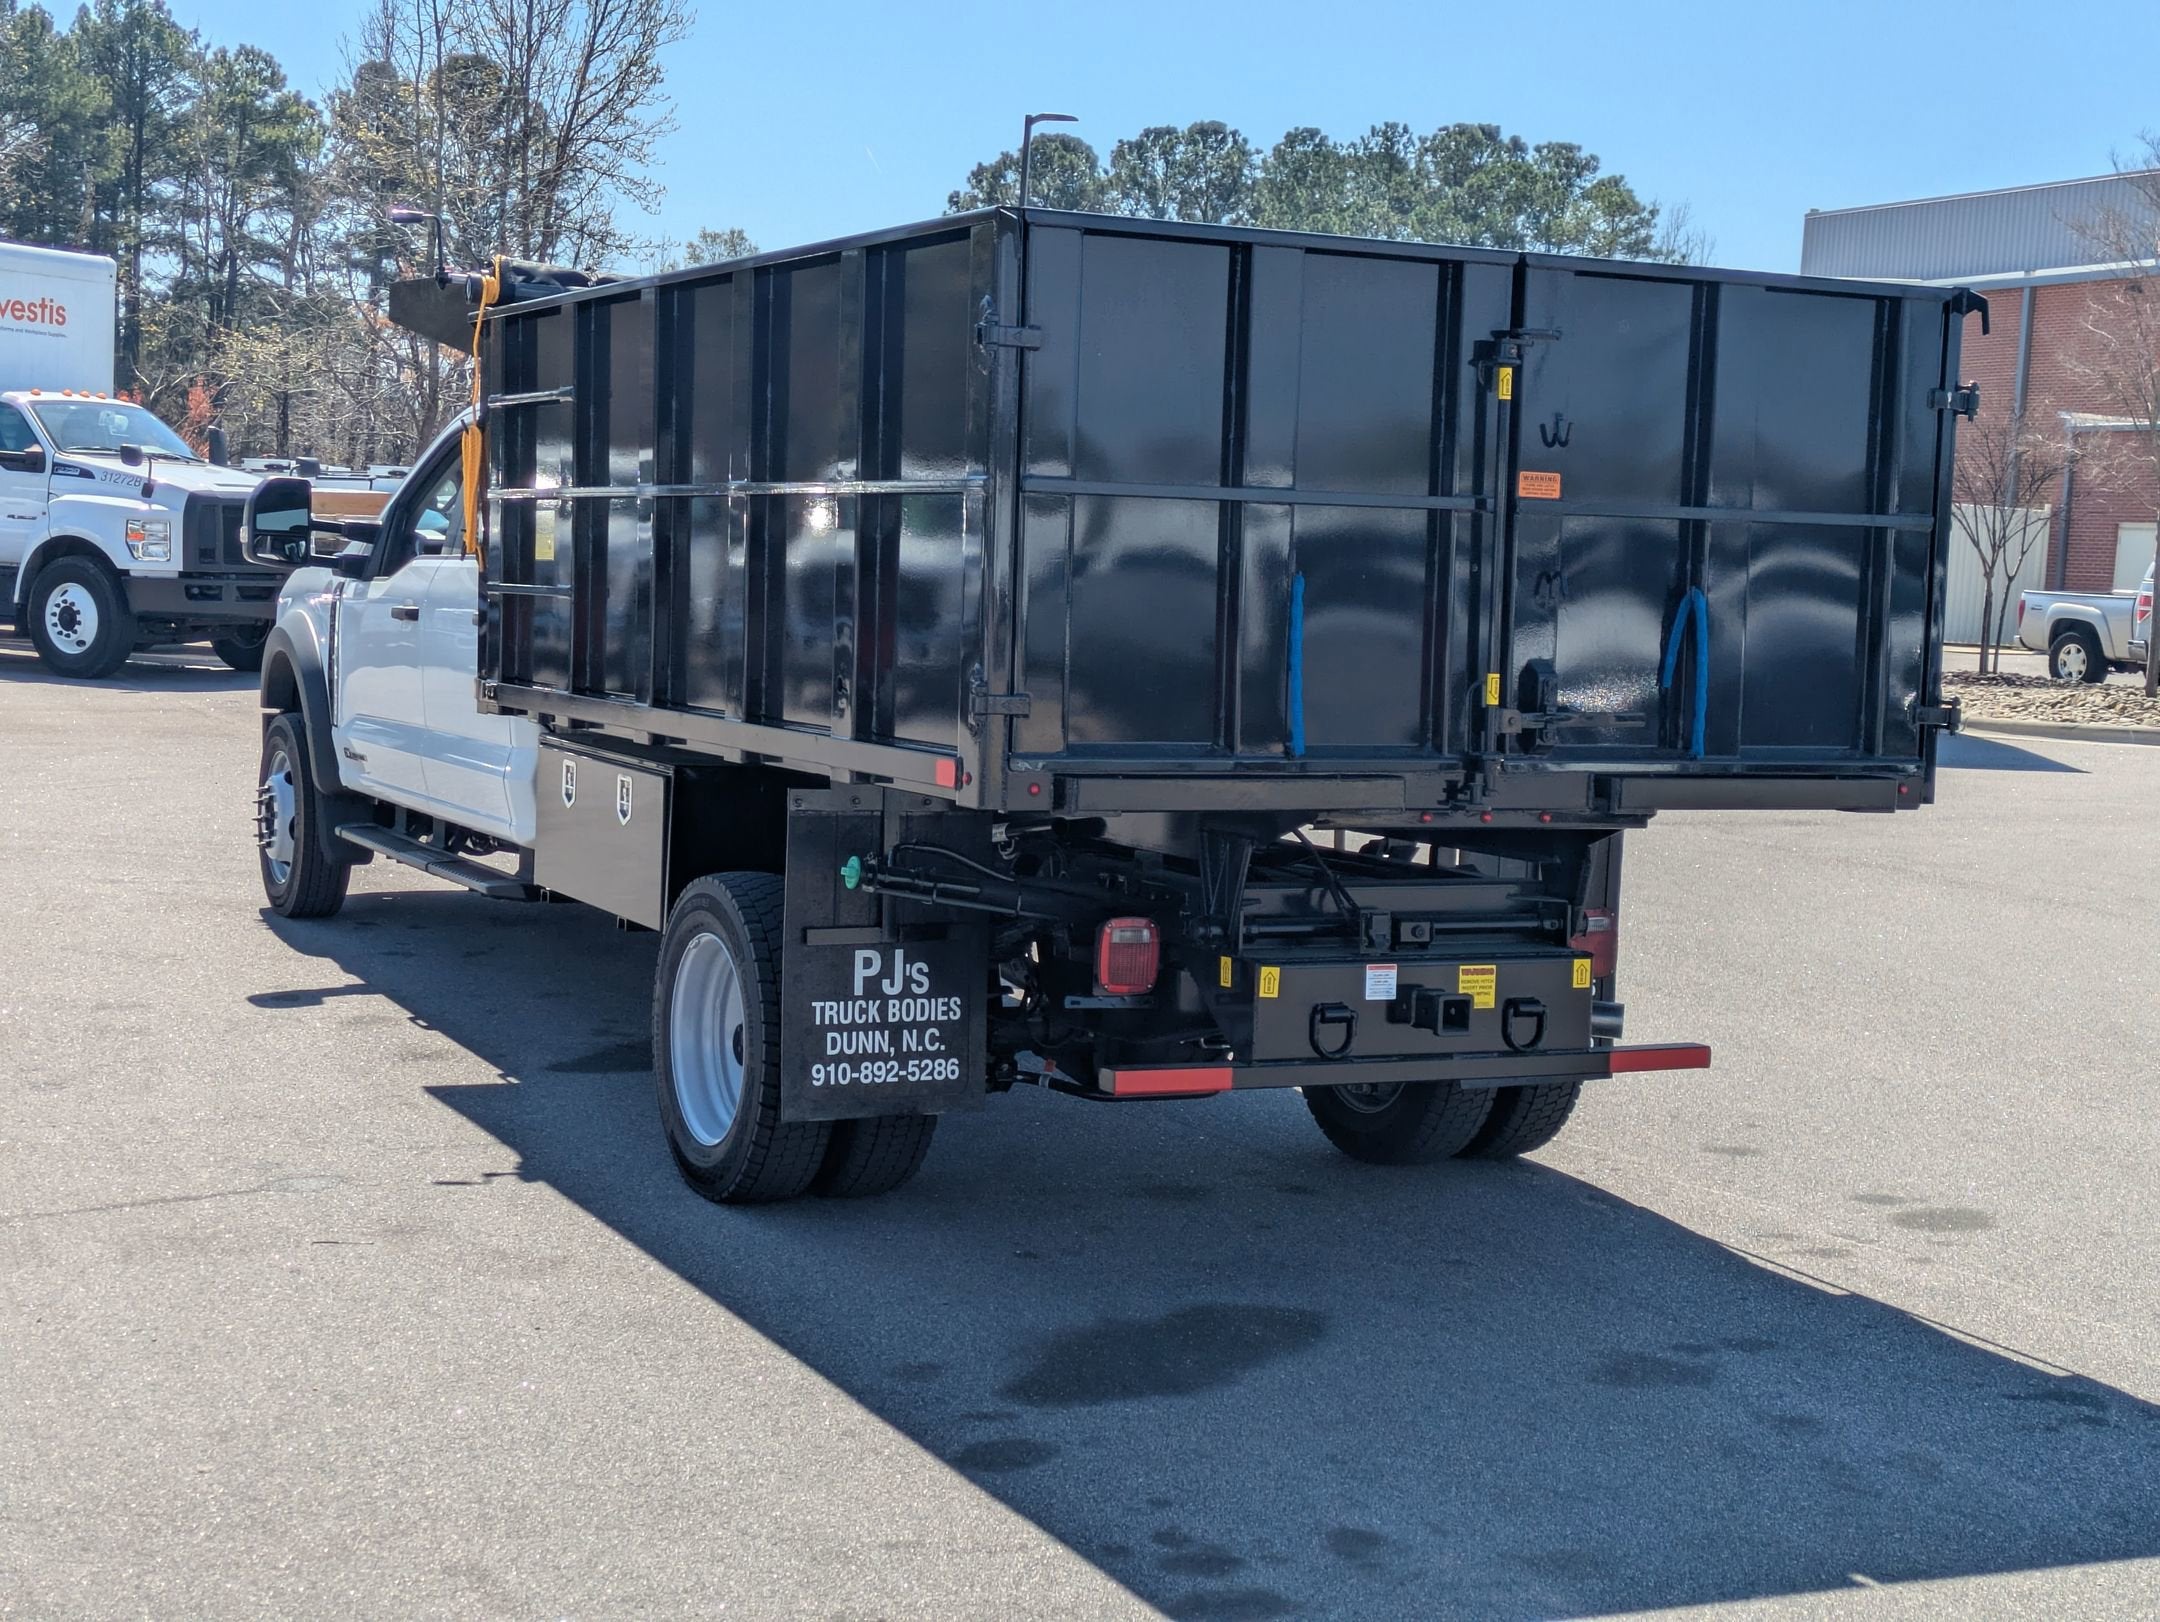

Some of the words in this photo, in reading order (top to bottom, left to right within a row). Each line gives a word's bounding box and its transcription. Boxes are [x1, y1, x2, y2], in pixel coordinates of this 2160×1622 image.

[0, 297, 66, 326] vestis
[812, 1000, 881, 1025] TRUCK
[888, 997, 961, 1023] BODIES
[826, 1030, 895, 1057] DUNN,
[902, 1028, 946, 1052] N.C.
[811, 1058, 960, 1086] 910-892-5286
